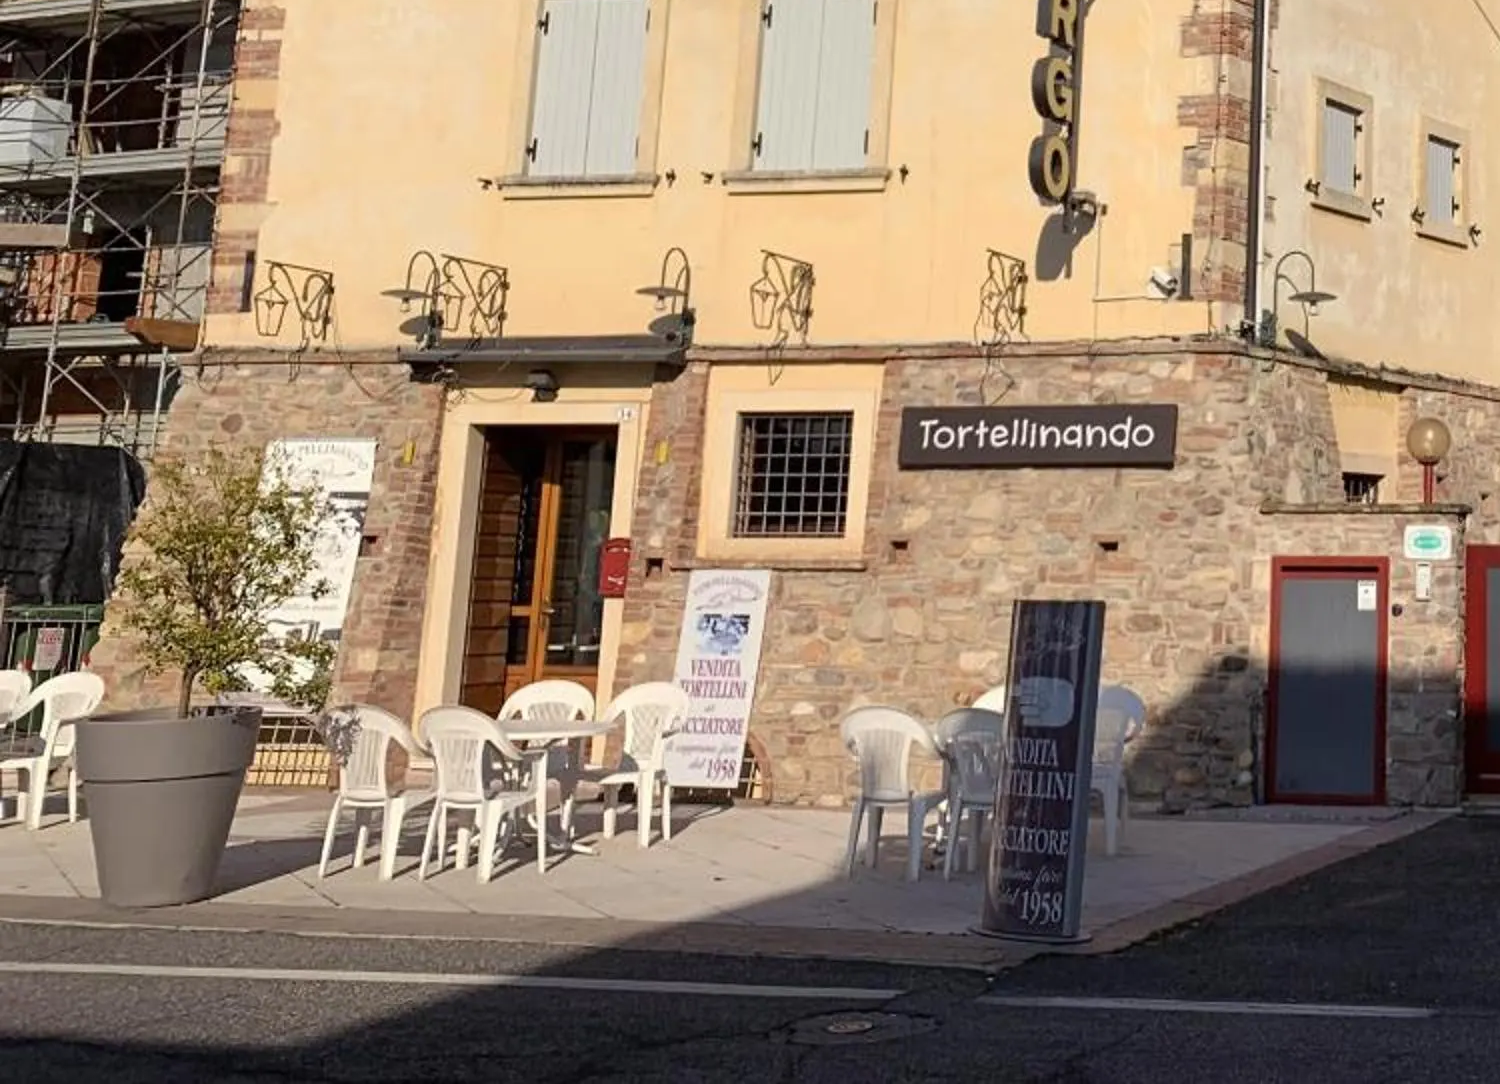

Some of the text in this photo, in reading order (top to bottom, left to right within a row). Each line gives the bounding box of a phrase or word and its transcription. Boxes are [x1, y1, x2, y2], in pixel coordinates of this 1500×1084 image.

[919, 415, 1155, 449] Tortellinando
[691, 658, 742, 677] VENDITA
[680, 679, 747, 698] TORTELLINI
[705, 758, 737, 781] 1958
[1019, 890, 1063, 924] 1958
